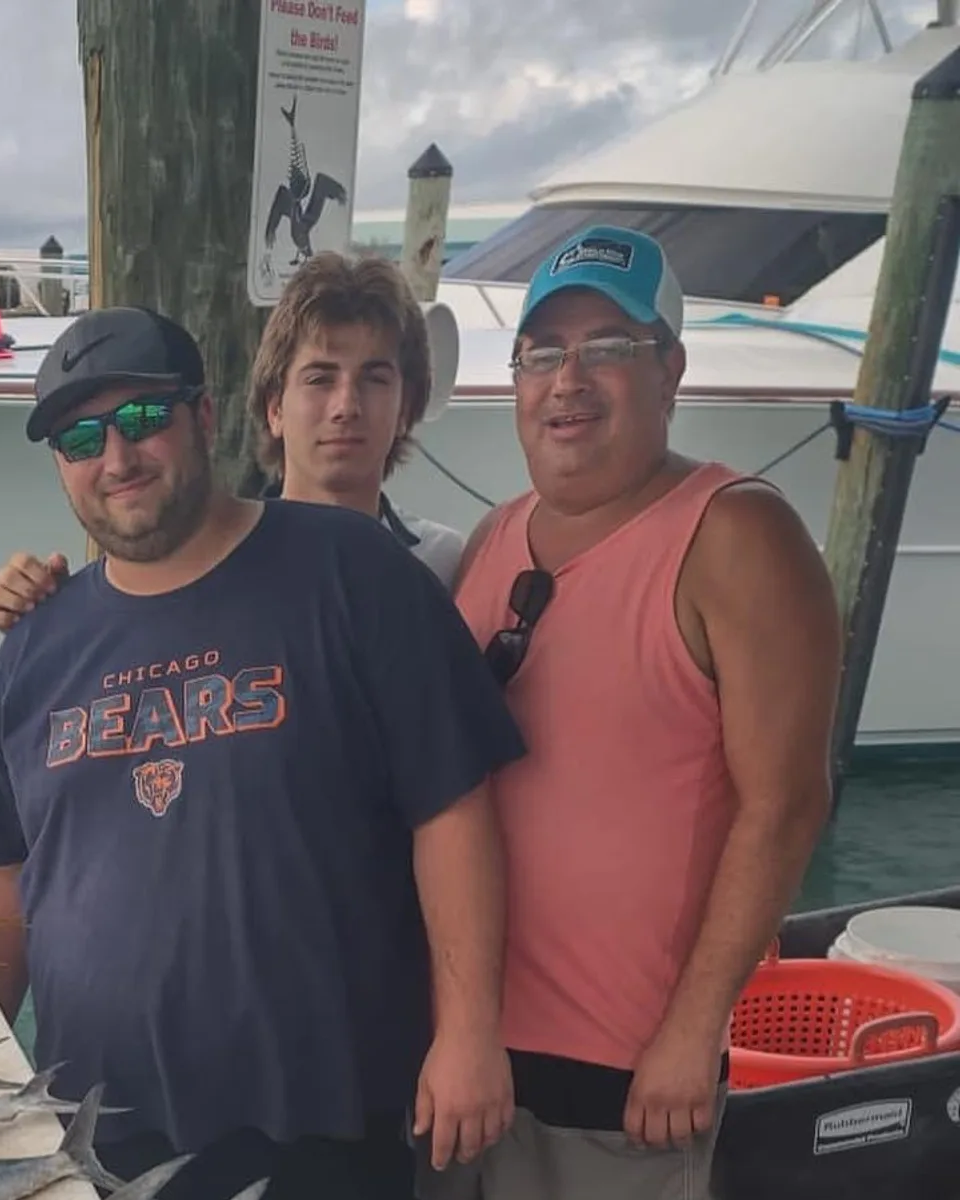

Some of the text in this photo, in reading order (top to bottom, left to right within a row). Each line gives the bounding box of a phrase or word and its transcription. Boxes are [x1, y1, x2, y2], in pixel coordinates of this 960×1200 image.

[270, 0, 358, 25] Please Don't Feed
[290, 28, 339, 52] the Birds!
[103, 650, 220, 689] CHICAGO
[46, 664, 288, 769] BEARS
